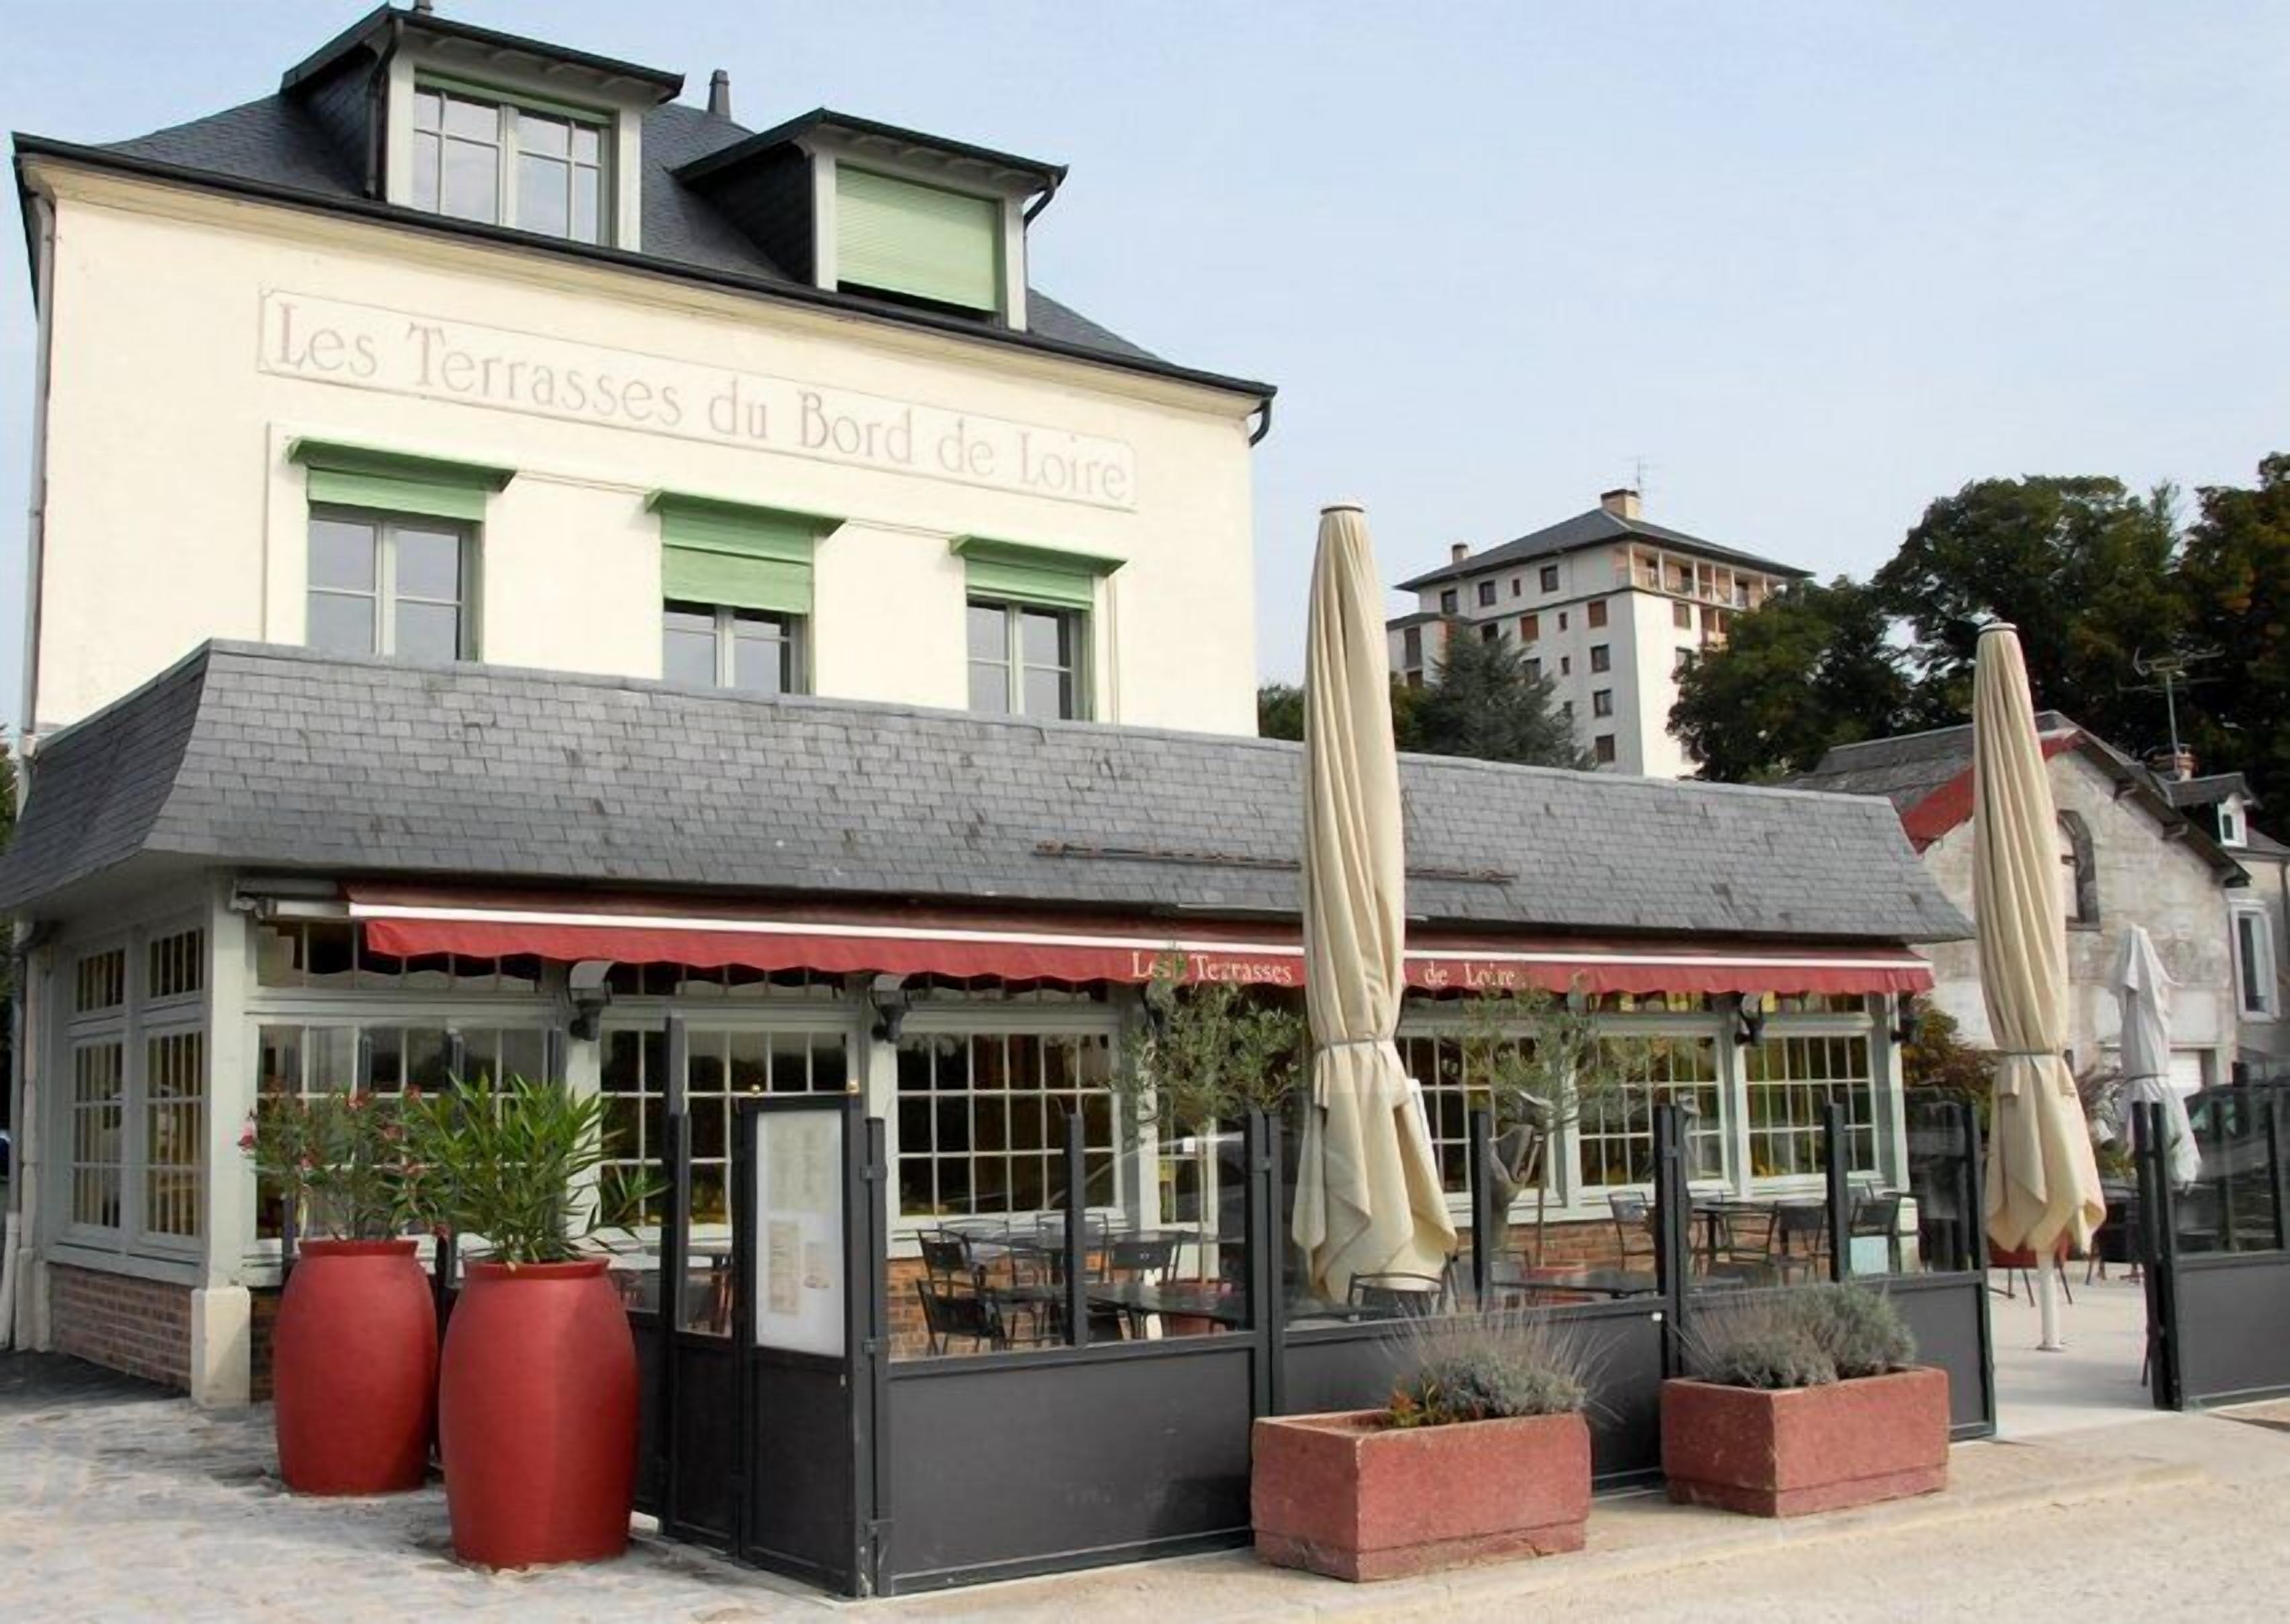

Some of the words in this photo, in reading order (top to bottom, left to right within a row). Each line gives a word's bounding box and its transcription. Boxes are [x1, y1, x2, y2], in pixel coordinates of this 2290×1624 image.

[278, 302, 378, 378] Les
[406, 322, 683, 427] Terrasses
[708, 380, 768, 440] du
[797, 389, 913, 464] Bord
[938, 419, 995, 476] de
[1019, 431, 1126, 501] Loire
[1188, 952, 1293, 983] Terrasses
[1424, 960, 1448, 986] de
[1464, 962, 1515, 986] Loire
